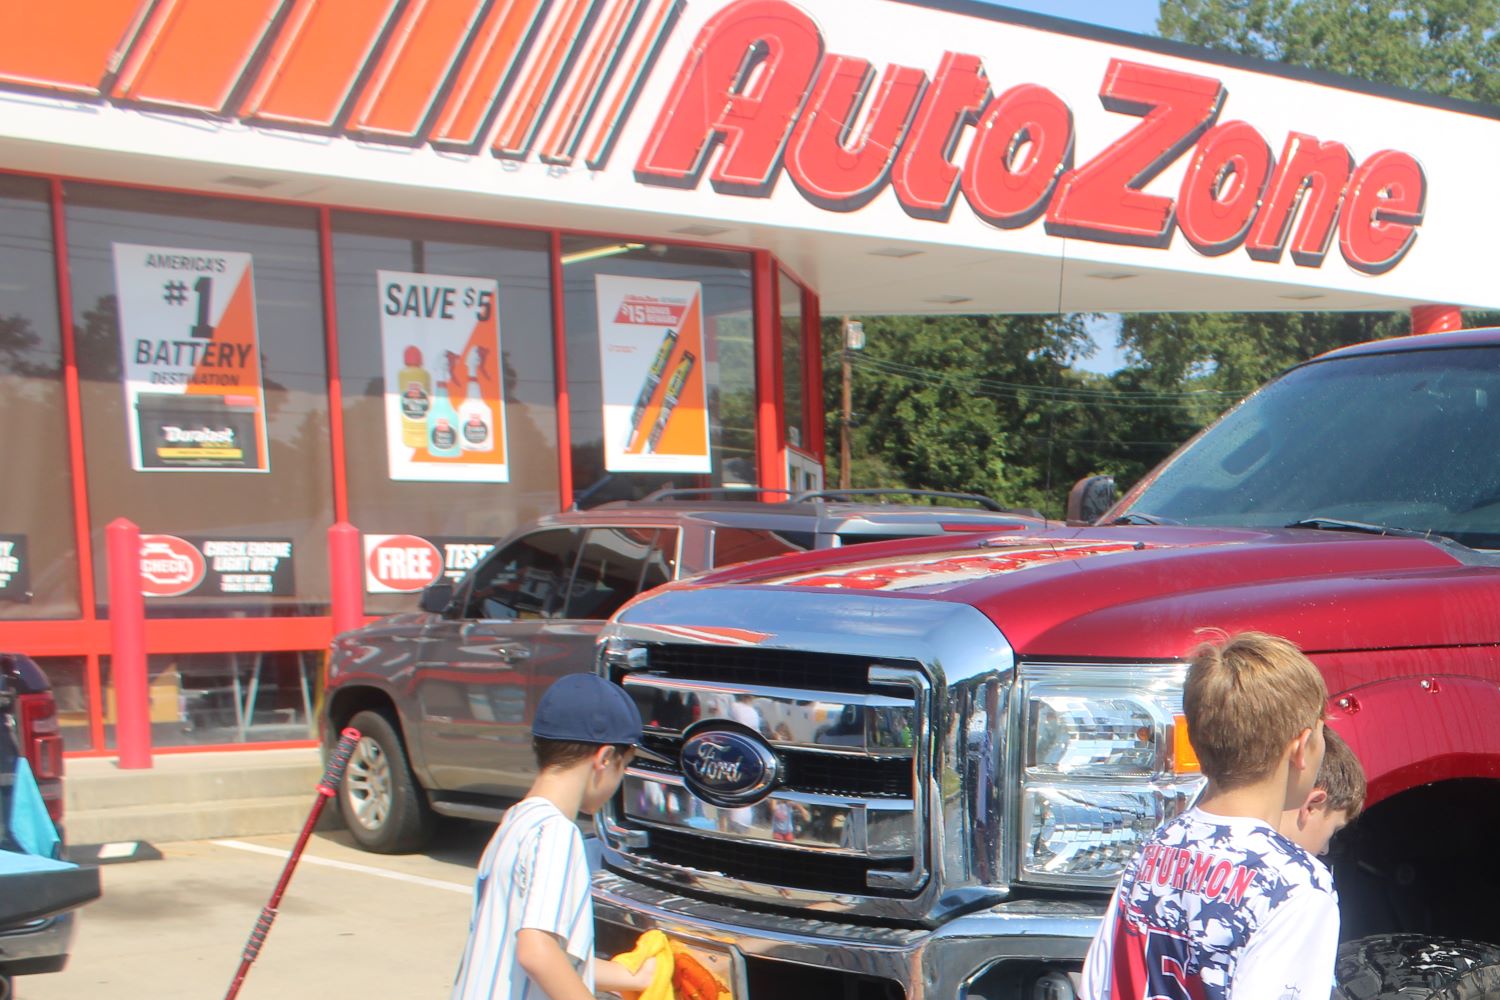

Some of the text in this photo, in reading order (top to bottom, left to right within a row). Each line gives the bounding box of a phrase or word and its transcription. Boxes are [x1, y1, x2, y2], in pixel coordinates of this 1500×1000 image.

[633, 0, 1427, 276] AutoZone
[147, 253, 227, 273] AMERICA'S
[163, 276, 214, 338] #1
[385, 283, 493, 322] SAVE $5
[135, 338, 253, 369] BATTERY
[377, 547, 433, 580] FREE
[695, 741, 743, 783] Ford
[1135, 844, 1258, 908] HURMON
